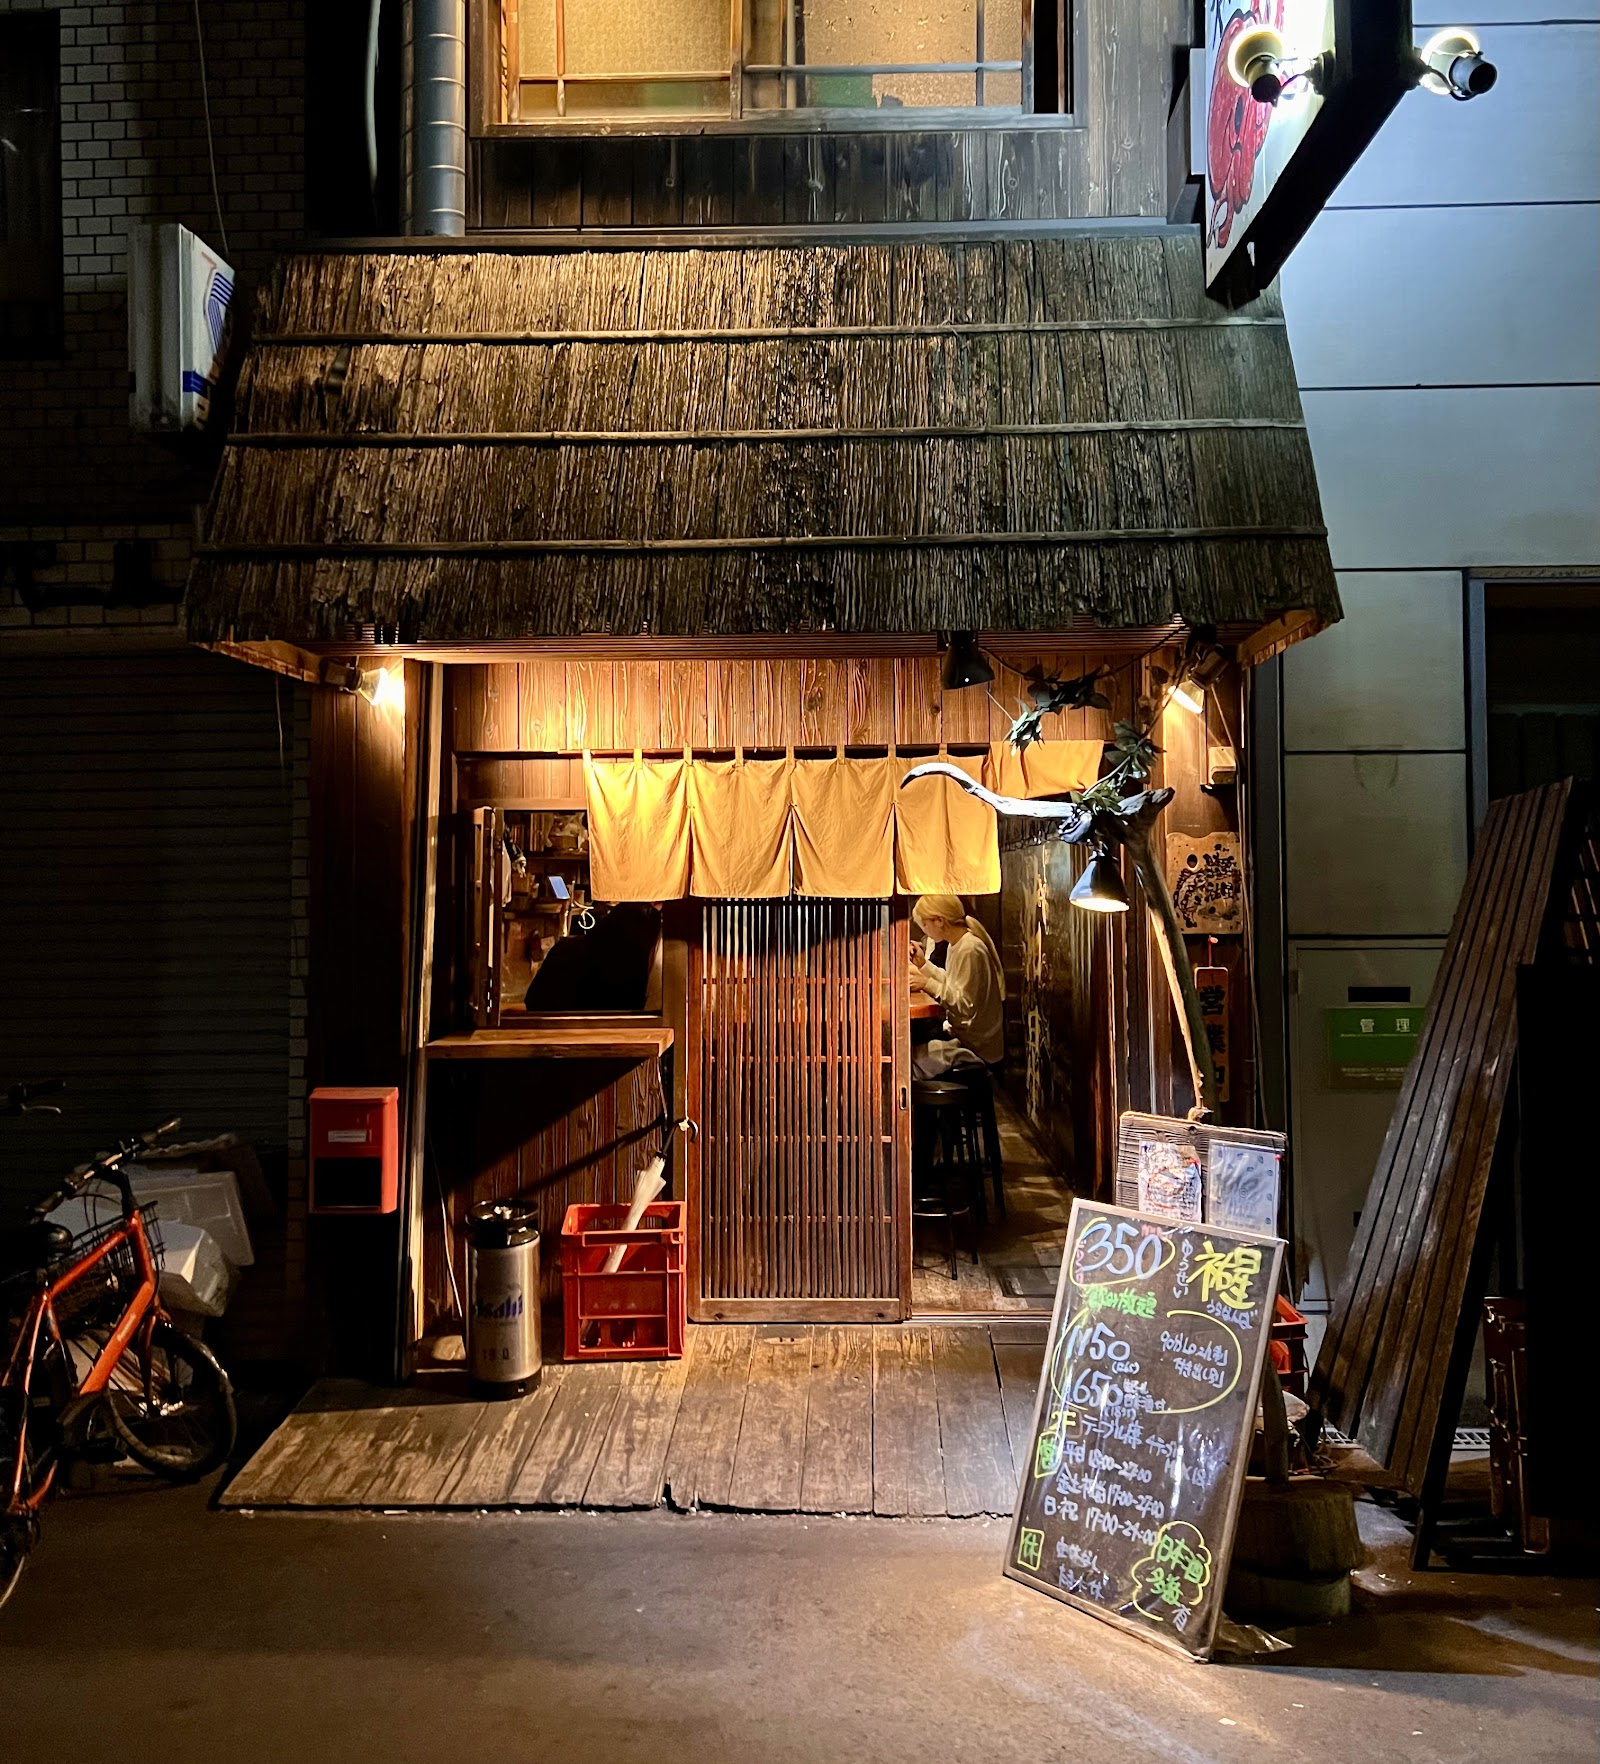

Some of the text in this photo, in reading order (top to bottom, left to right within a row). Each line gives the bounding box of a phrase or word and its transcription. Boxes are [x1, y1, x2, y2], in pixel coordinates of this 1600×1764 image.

[1082, 1223, 1162, 1279] 350
[1172, 1239, 1194, 1299] ゆうせい
[1048, 1410, 1077, 1431] 2F
[1081, 1413, 1144, 1449] テーブル席
[1063, 1439, 1086, 1464] 平日
[1023, 1532, 1039, 1565] 休
[1156, 1534, 1207, 1584] 日本酒
[1172, 1604, 1192, 1632] 有
